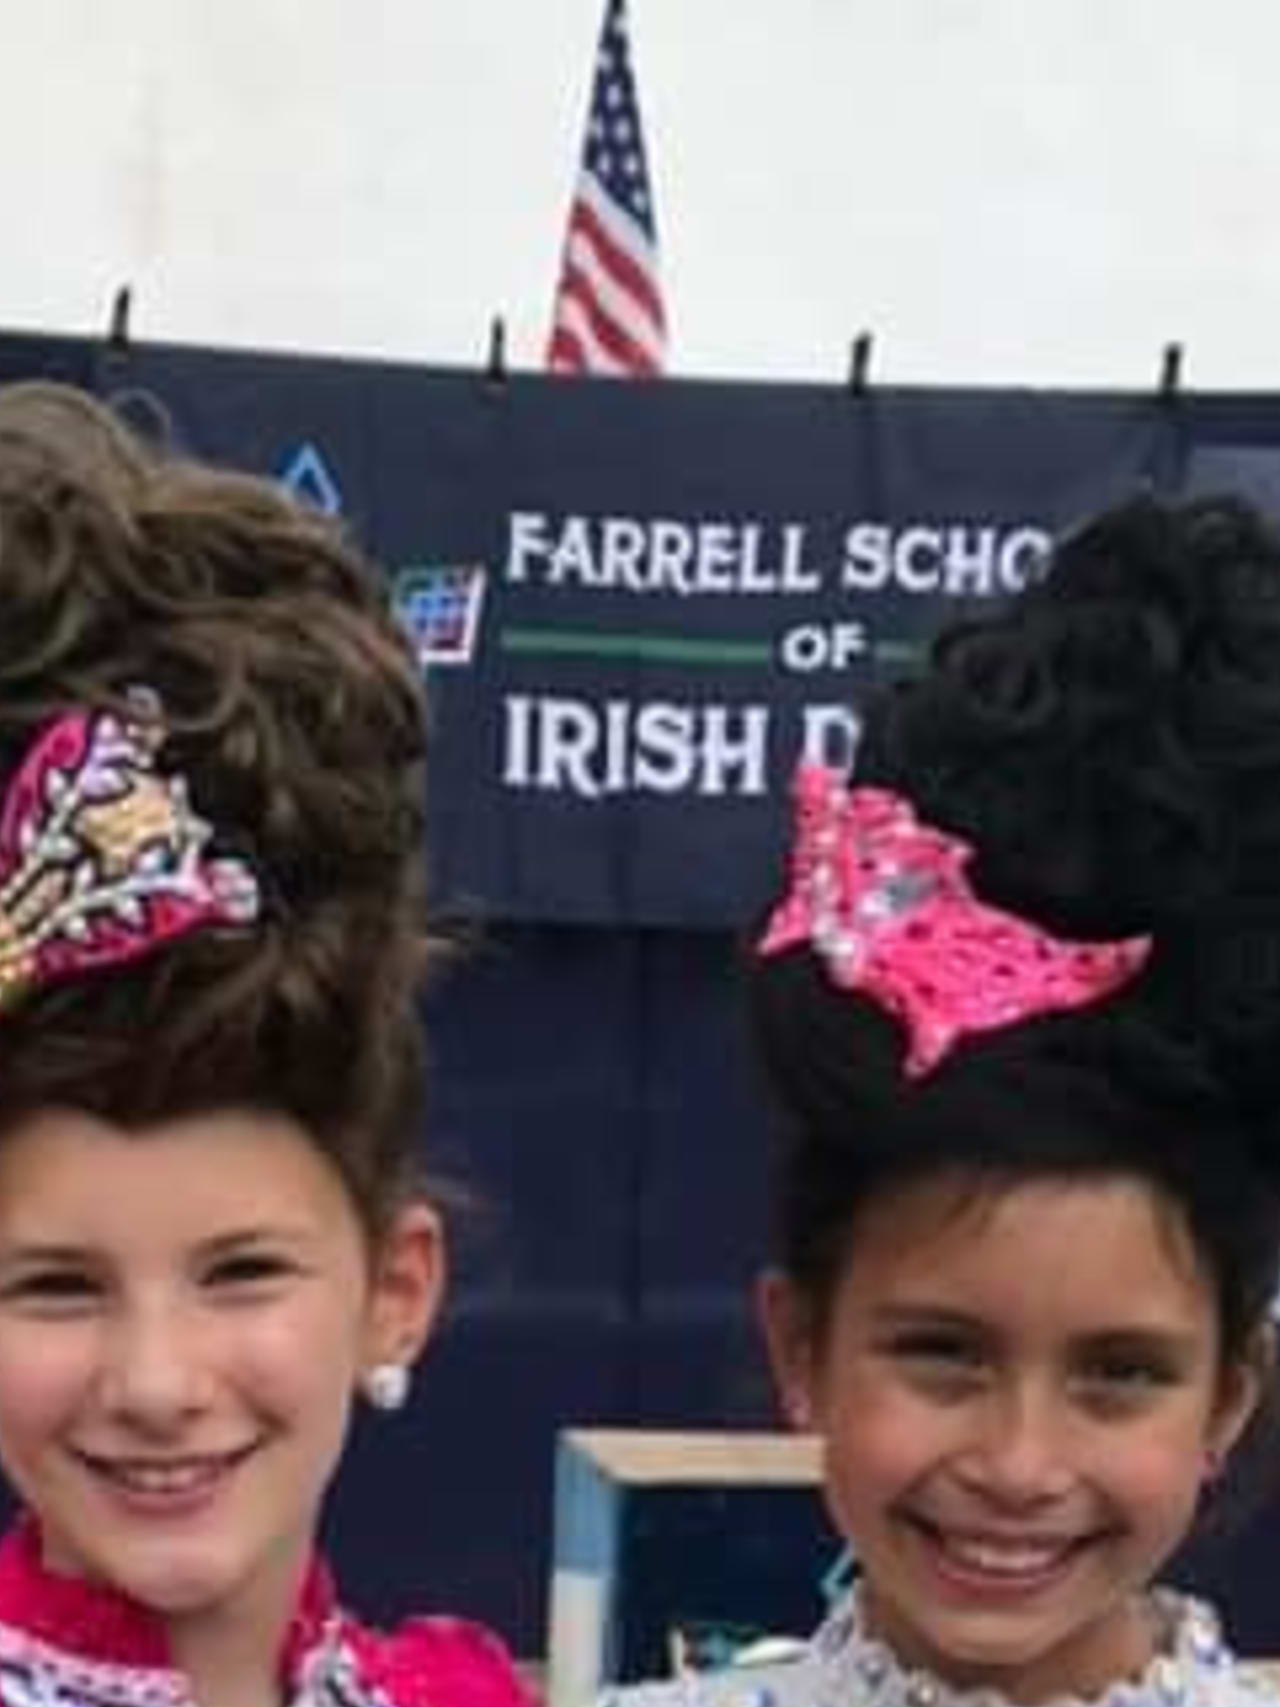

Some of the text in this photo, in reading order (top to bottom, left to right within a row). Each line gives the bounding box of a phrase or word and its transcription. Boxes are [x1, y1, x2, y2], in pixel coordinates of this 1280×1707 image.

[505, 510, 1054, 595] FARRELL SCHO
[781, 622, 866, 672] OF
[501, 694, 768, 798] IRISH
